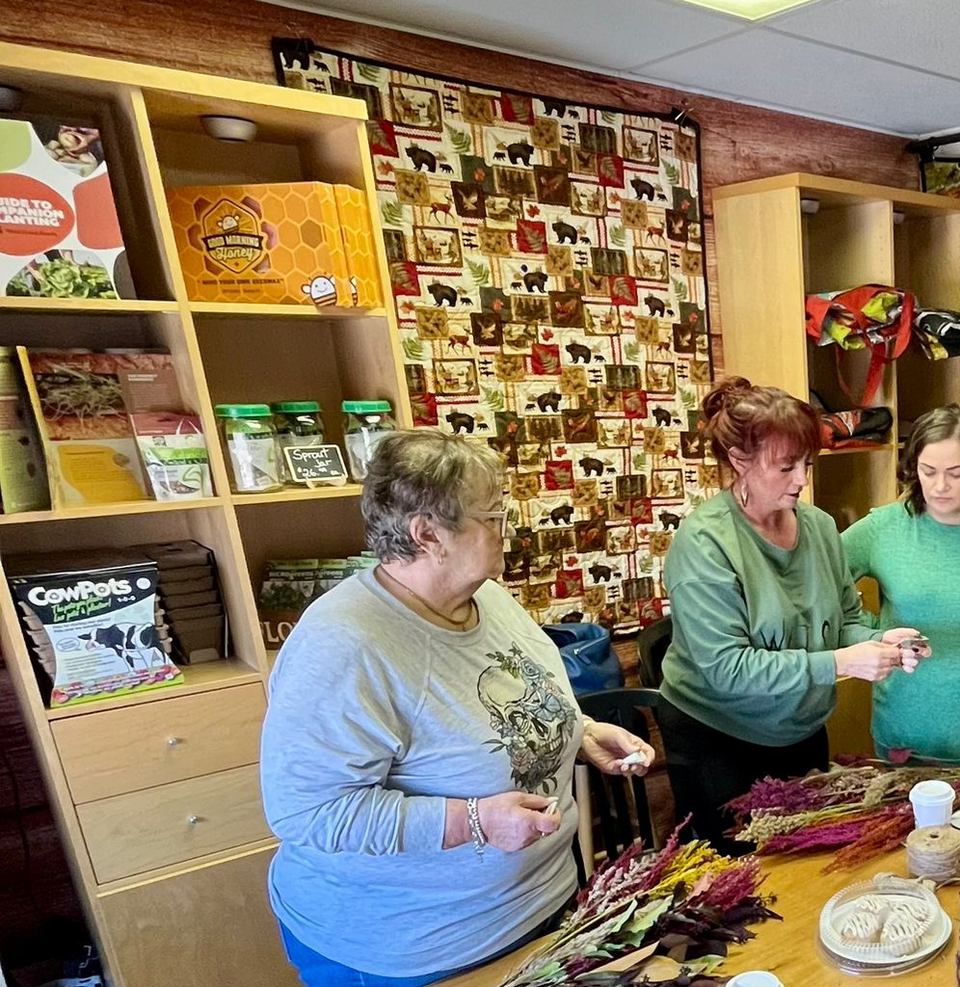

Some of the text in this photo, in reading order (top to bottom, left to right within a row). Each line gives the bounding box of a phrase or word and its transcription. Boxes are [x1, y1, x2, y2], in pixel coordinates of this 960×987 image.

[30, 199, 53, 211] TO
[216, 247, 254, 262] Honey
[292, 448, 330, 462] Sprout
[27, 577, 132, 606] CowPots
